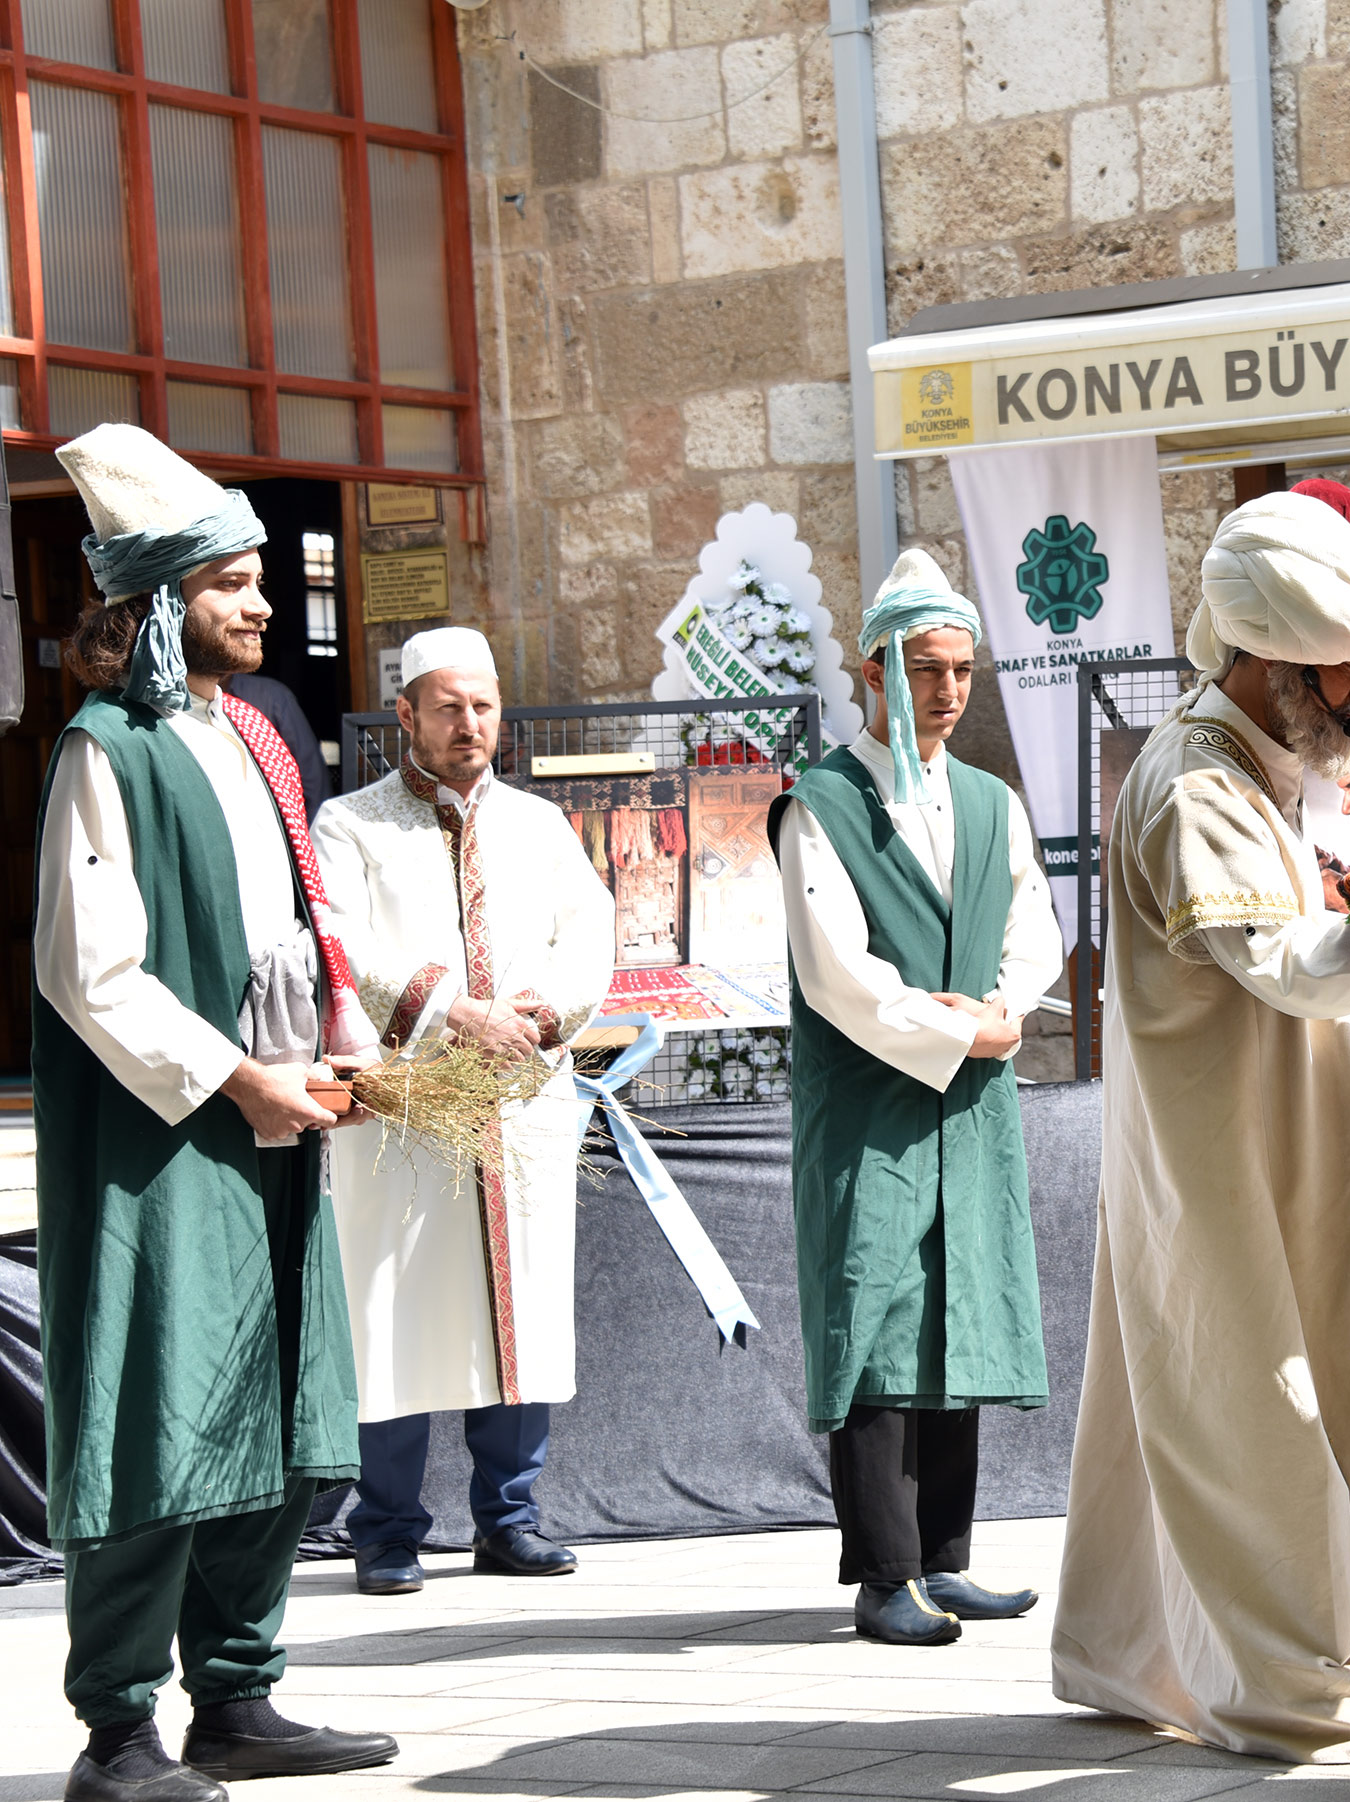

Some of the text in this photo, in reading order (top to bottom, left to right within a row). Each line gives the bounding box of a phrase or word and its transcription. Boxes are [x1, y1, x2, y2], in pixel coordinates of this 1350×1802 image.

[998, 356, 1205, 426] KONYA
[921, 407, 953, 419] KONYA
[696, 622, 731, 669] EREĞLİ
[1047, 638, 1083, 652] KONYA
[995, 643, 1153, 673] SNAF VE SANATKARLAR
[1018, 671, 1072, 690] ODALARI
